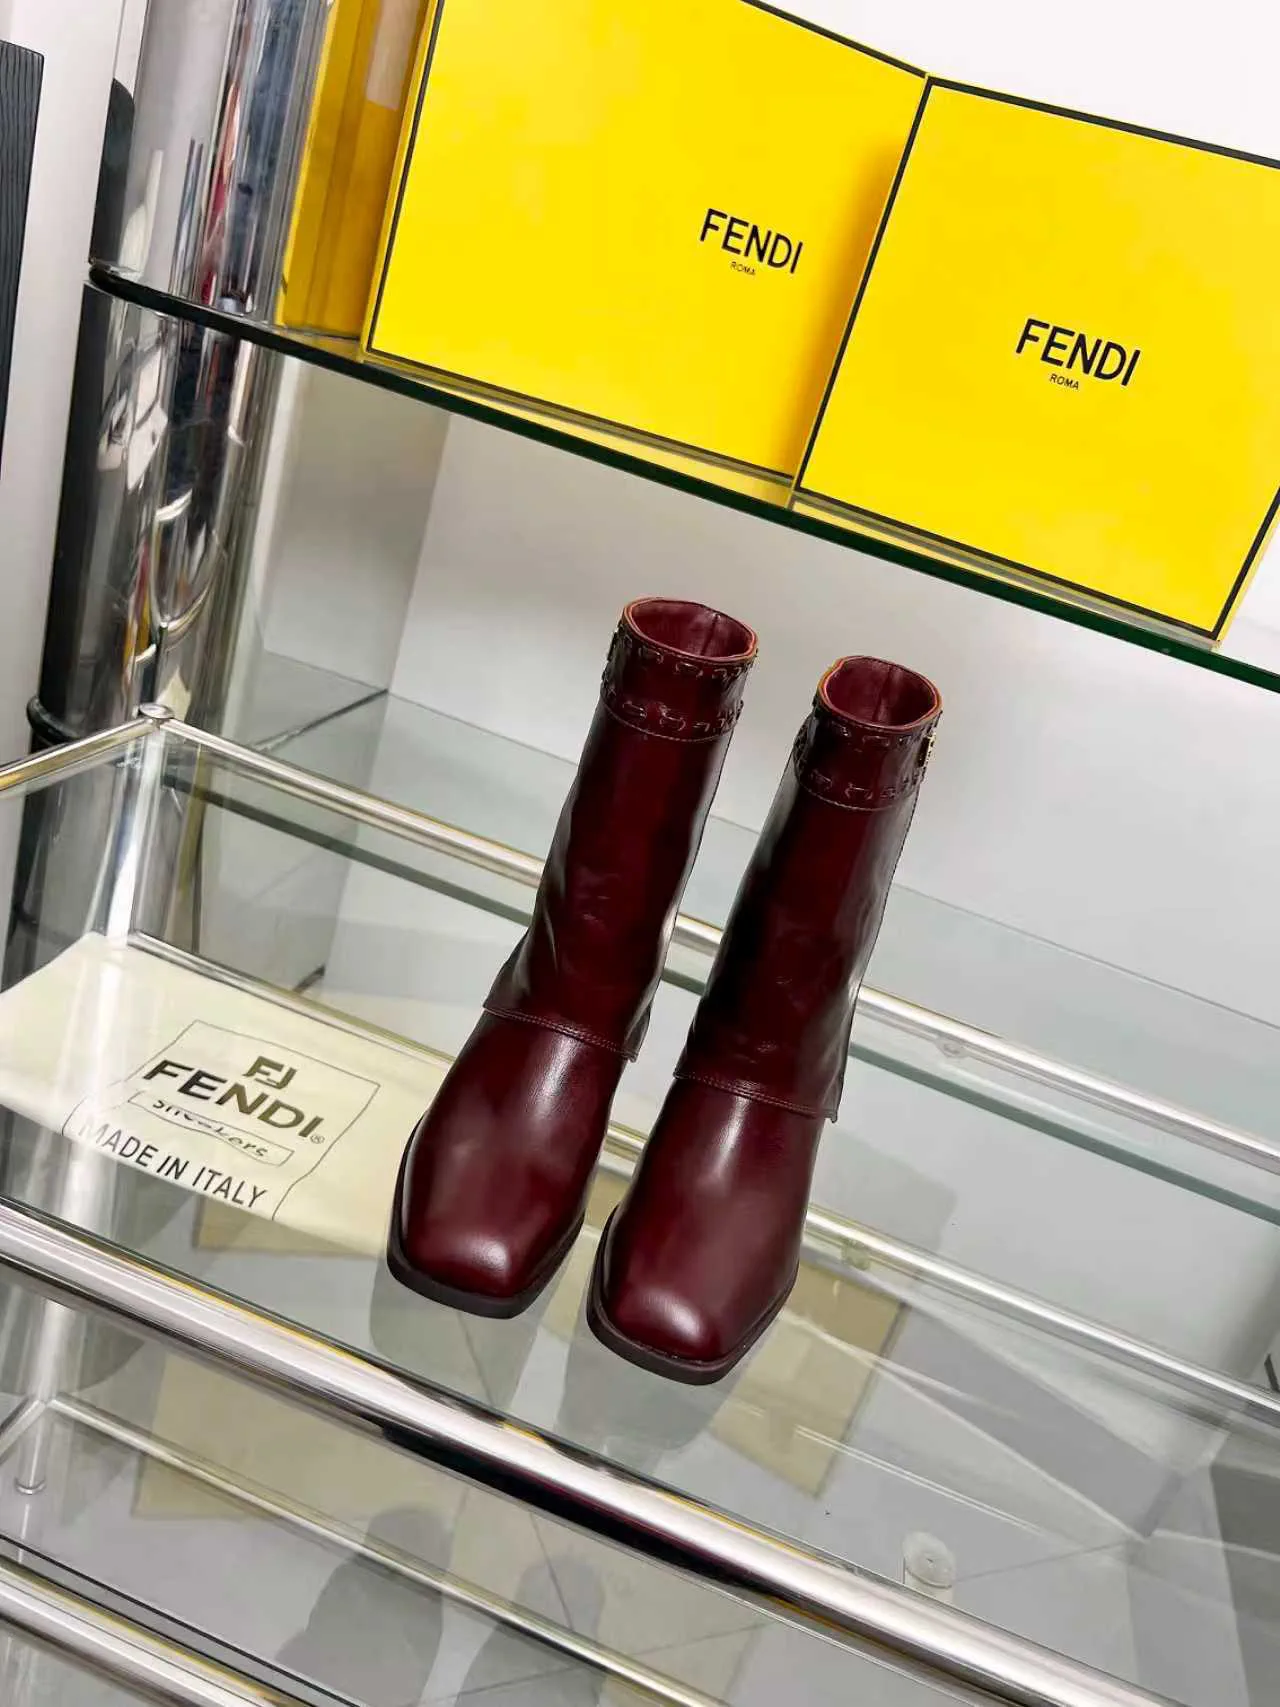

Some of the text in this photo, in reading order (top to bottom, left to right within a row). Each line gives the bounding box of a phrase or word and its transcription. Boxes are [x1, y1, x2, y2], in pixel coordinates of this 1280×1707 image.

[699, 207, 804, 274] FENDI
[730, 260, 756, 276] ROMA
[1015, 318, 1141, 388] FENDI
[1049, 373, 1079, 390] ROMA
[78, 1123, 268, 1208] MADE IN ITALY
